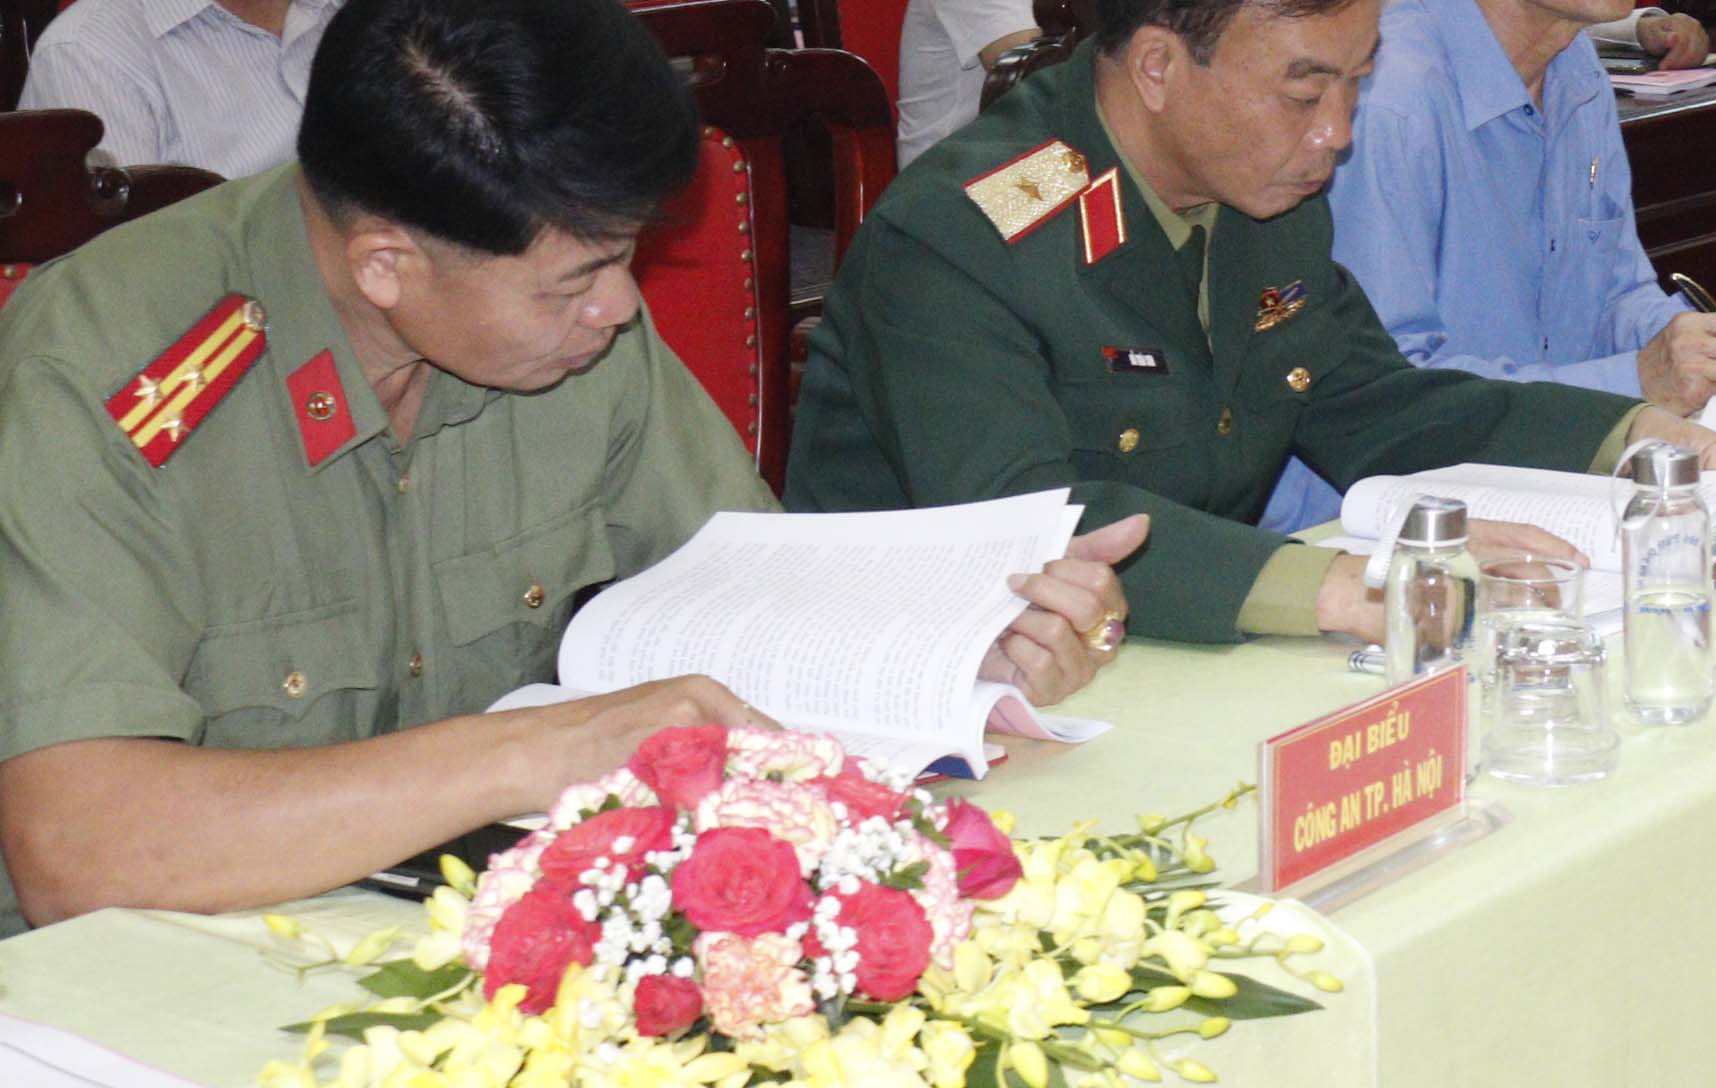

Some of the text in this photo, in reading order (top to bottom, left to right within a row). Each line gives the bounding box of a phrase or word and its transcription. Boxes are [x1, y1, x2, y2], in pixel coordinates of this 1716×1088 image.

[1329, 700, 1410, 771] ĐẠI BIỂU
[1294, 749, 1443, 852] CÔNG AN TP. HÀ NỘI
